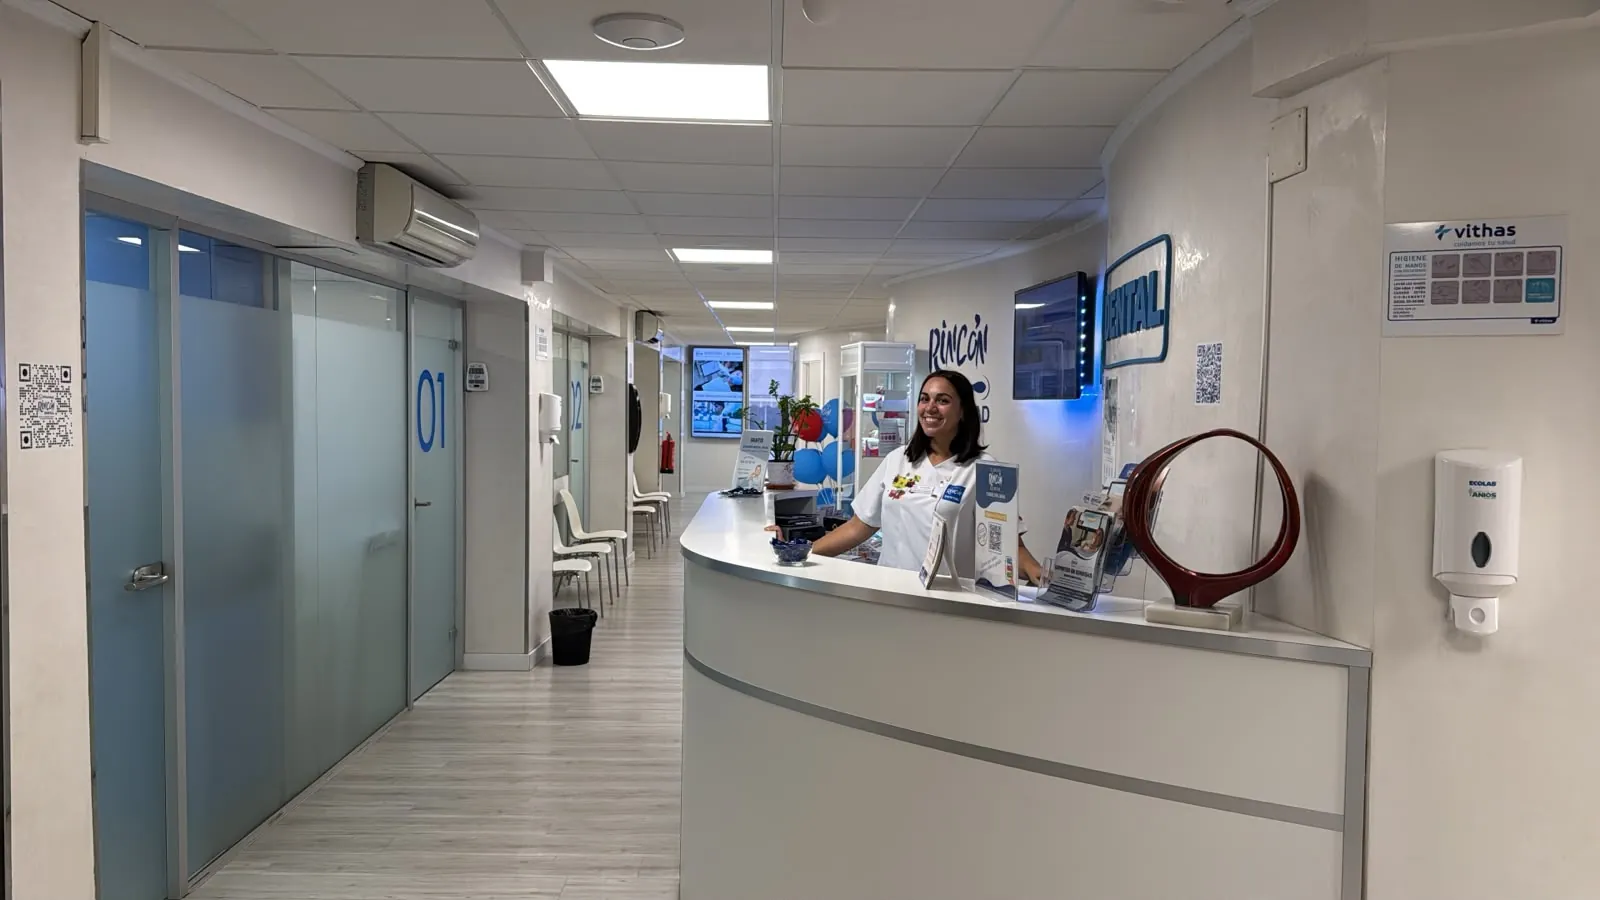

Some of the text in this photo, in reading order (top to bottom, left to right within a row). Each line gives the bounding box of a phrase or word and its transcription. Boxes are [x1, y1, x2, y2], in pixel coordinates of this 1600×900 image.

[1453, 240, 1486, 248] cuidamos
[1454, 223, 1516, 238] vithas
[1104, 270, 1164, 341] DENTAL
[417, 369, 445, 453] 01
